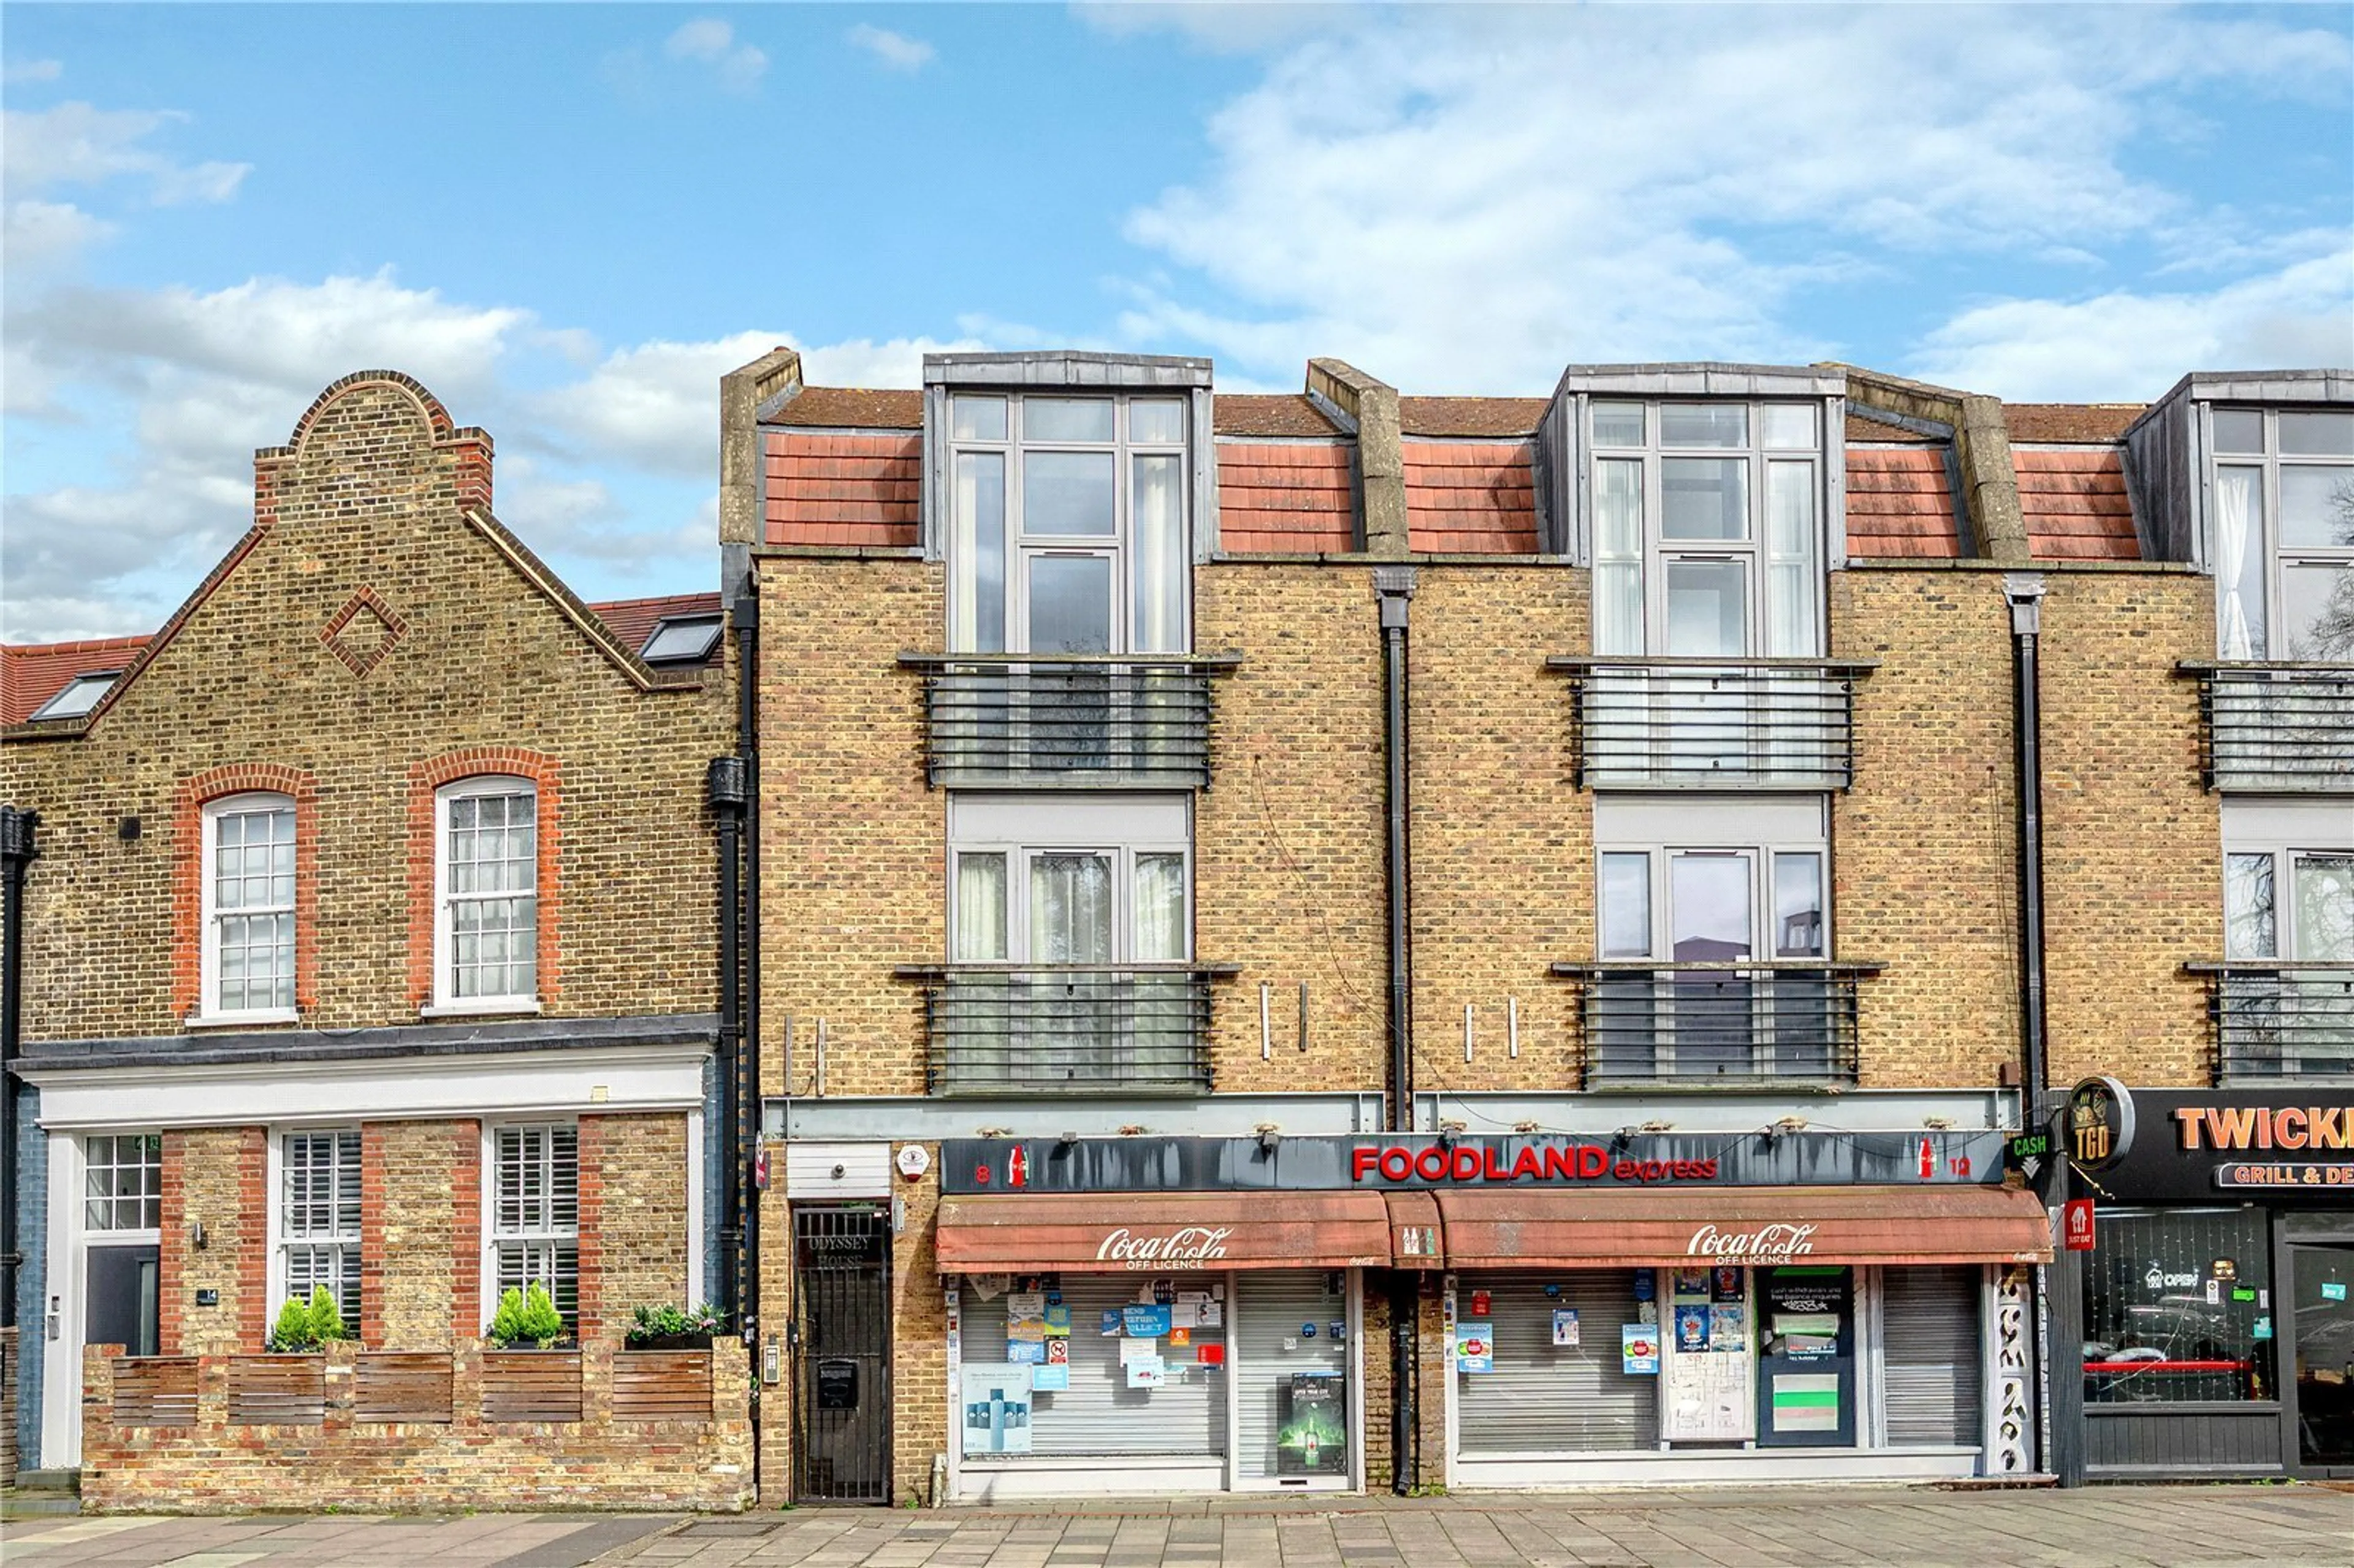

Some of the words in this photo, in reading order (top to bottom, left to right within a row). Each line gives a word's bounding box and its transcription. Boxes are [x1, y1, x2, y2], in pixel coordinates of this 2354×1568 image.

[2177, 1107, 2354, 1149] TWICK
[2014, 1135, 2046, 1156] CASH
[1352, 1146, 1609, 1181] FOODLAND
[1613, 1157, 1718, 1183] express
[976, 1165, 990, 1184] 8
[2234, 1166, 2298, 1184] GRILL
[2303, 1166, 2320, 1184] &
[2326, 1166, 2354, 1184] DE
[809, 1237, 869, 1250] ODYSSEY
[1096, 1227, 1235, 1260] Coca-Cola
[1688, 1224, 1819, 1255] Coca-Cola
[1126, 1260, 1150, 1270] OFF
[1154, 1260, 1204, 1269] LICENCE
[1716, 1256, 1739, 1265] OFF
[1742, 1255, 1792, 1264] LICENCE
[2164, 1274, 2199, 1287] OPEN
[207, 1290, 216, 1300] 14
